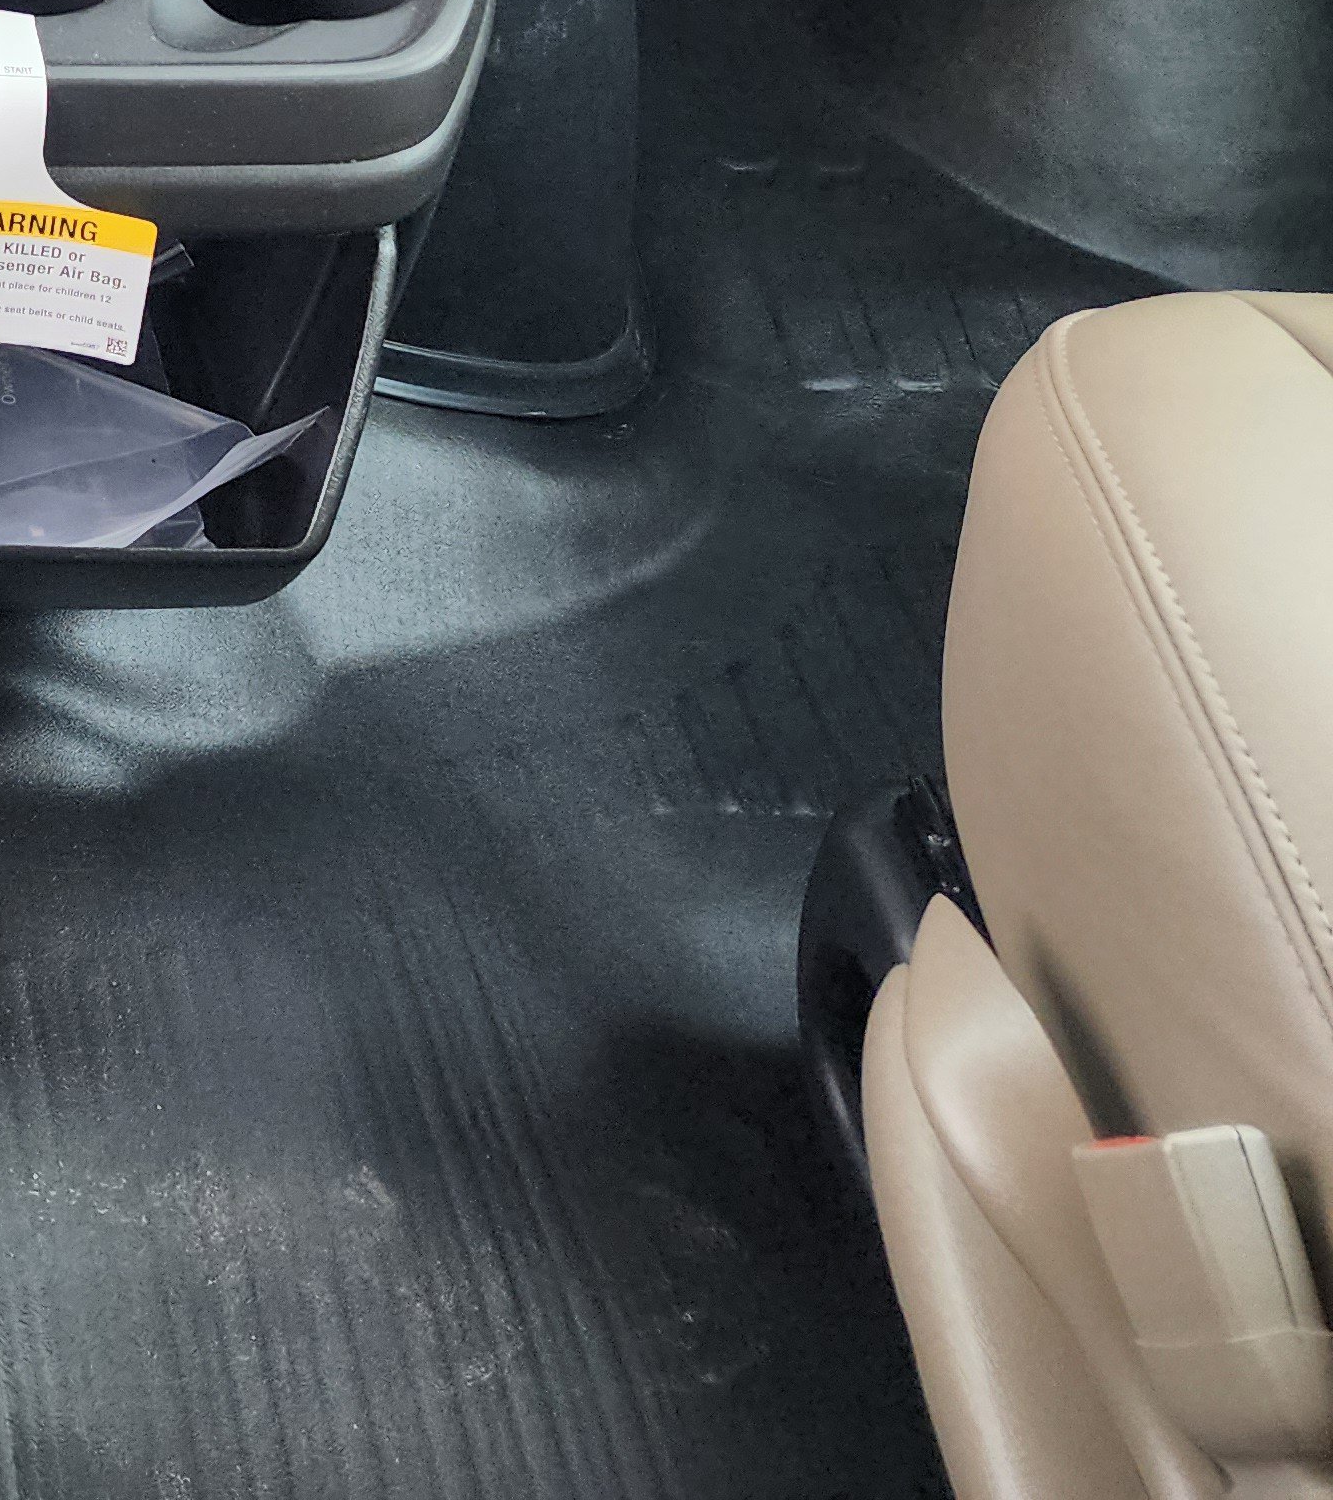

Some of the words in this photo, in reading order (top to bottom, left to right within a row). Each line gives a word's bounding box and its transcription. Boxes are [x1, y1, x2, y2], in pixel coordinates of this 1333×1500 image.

[3, 242, 62, 259] KILLED
[68, 251, 86, 263] or
[59, 265, 84, 280] Air
[90, 270, 127, 290] Bag.
[8, 281, 35, 291] place
[38, 284, 52, 293] for
[55, 287, 96, 301] children
[100, 294, 112, 304] 12
[4, 306, 26, 315] seat
[28, 307, 52, 318] belts
[69, 314, 94, 325] child
